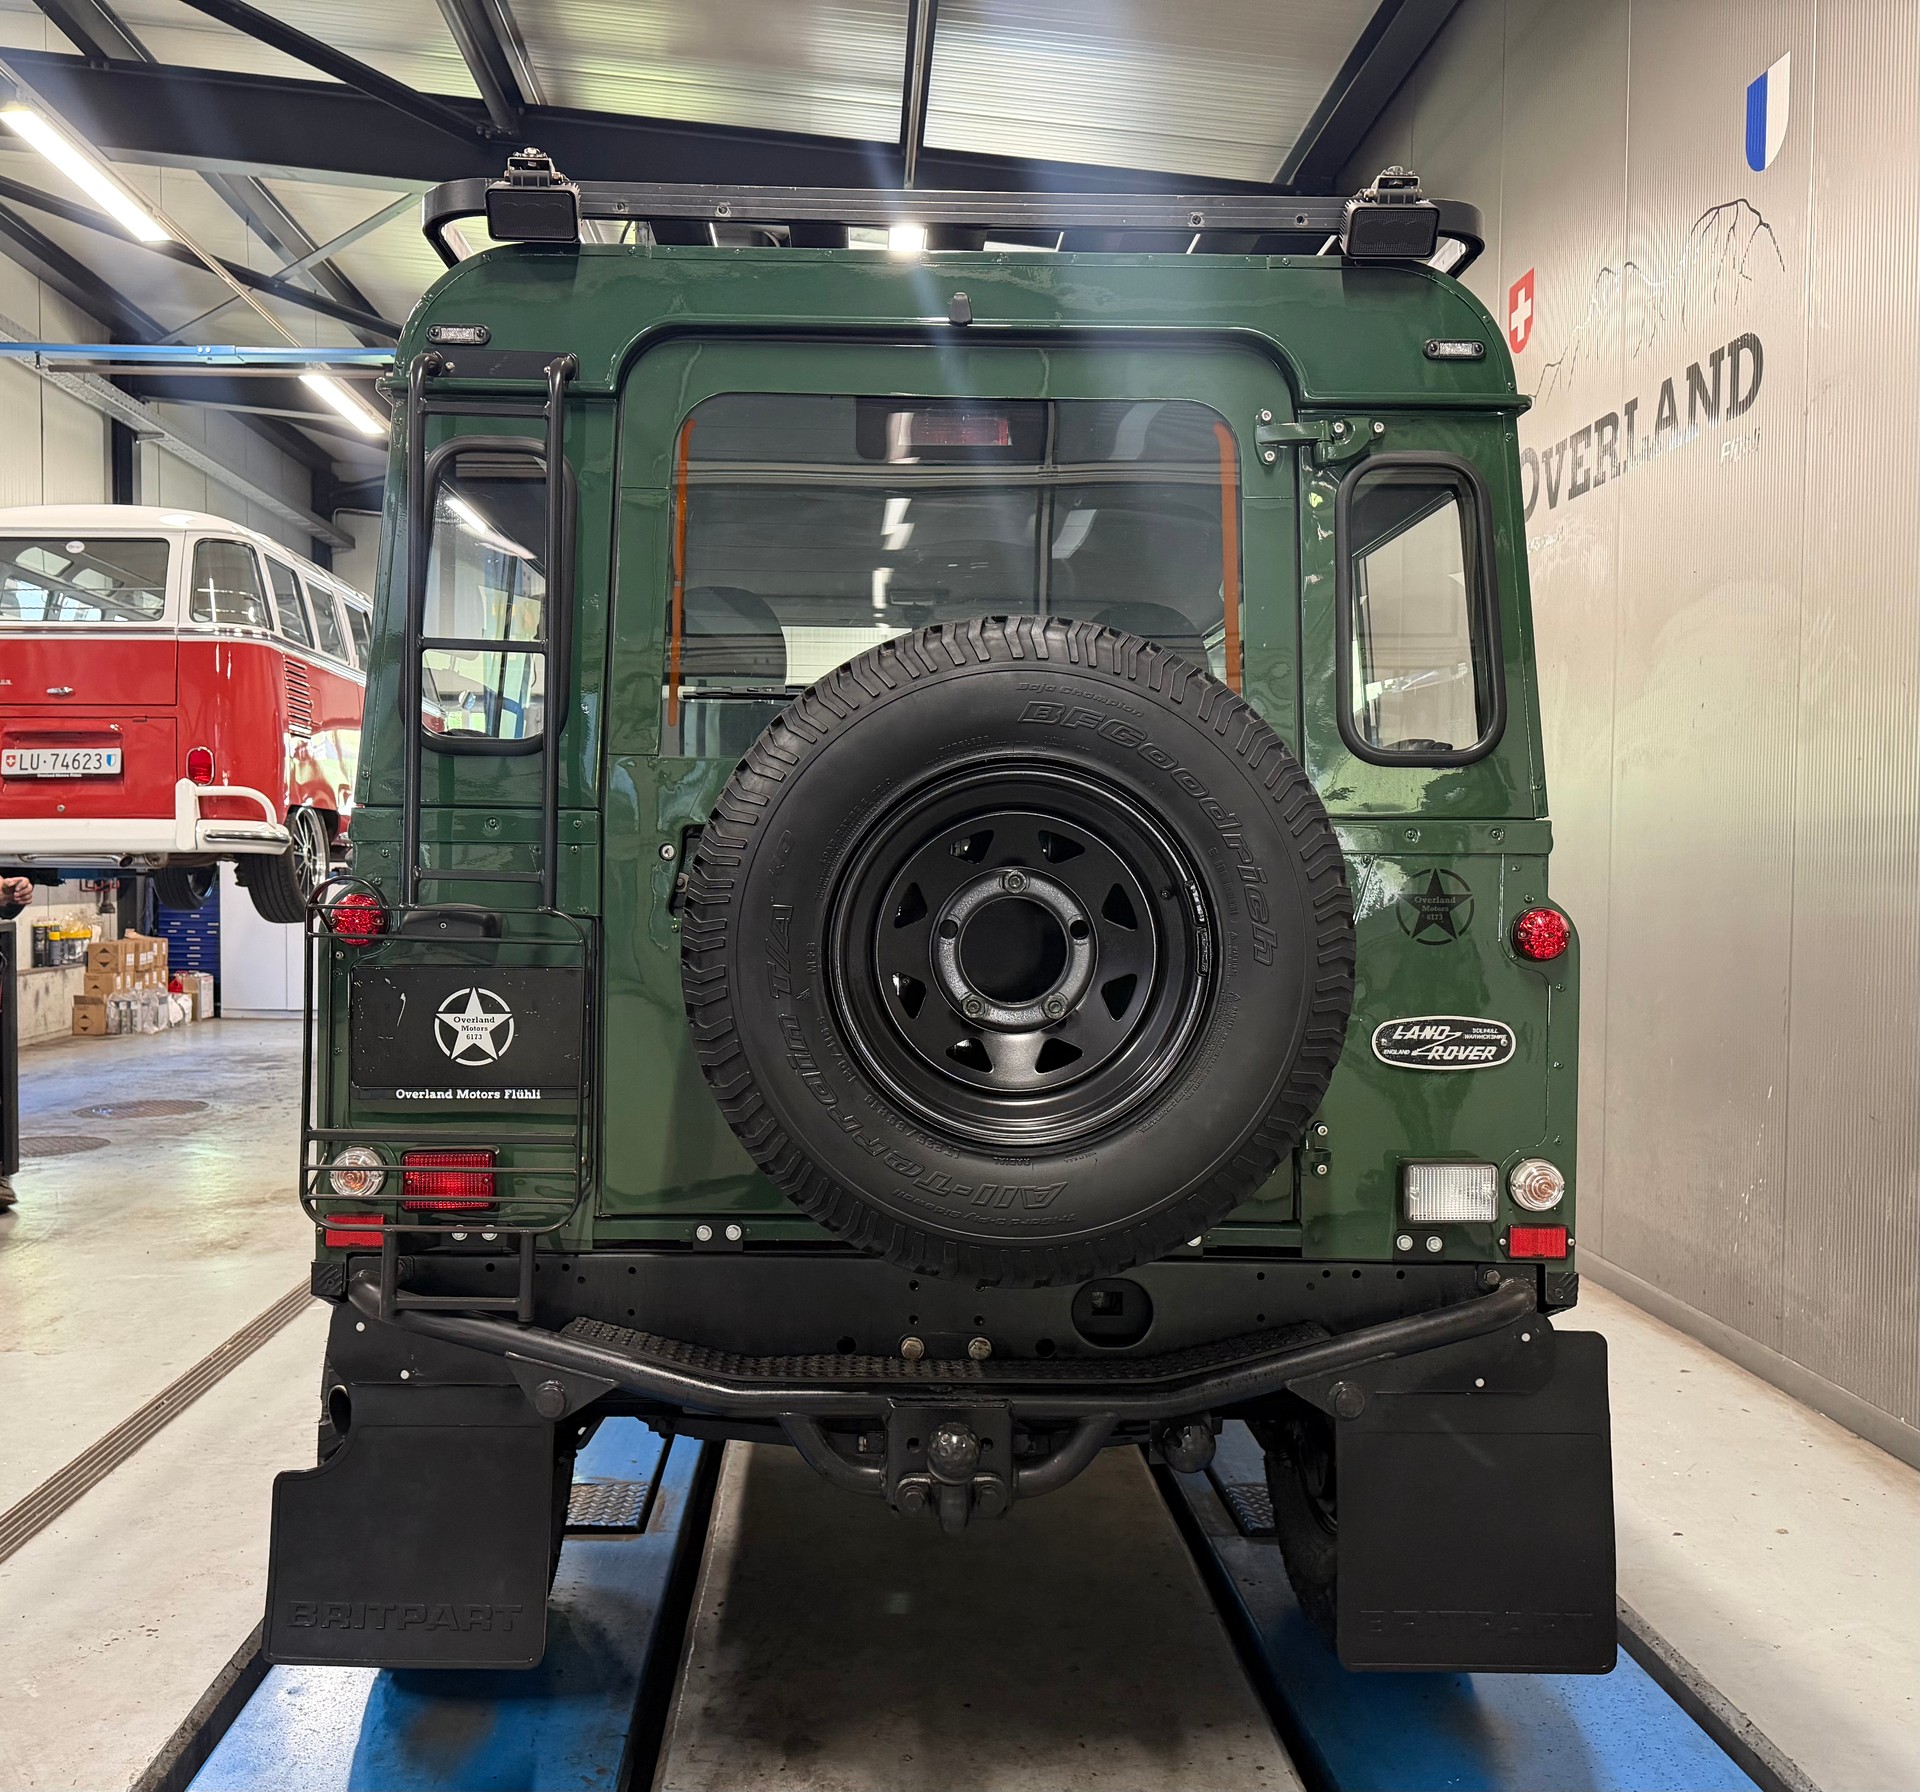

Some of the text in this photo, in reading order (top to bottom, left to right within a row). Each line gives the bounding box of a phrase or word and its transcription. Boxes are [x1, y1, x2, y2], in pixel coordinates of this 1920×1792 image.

[1521, 332, 1764, 523] OVERLAND
[1017, 700, 1277, 967] BFGoodrich
[768, 902, 795, 1000] T/A
[453, 1015, 495, 1024] Overland
[1392, 1025, 1451, 1040] LAND
[1427, 1045, 1498, 1060] ROVER
[395, 1089, 541, 1100] Overland Motors Flühli
[778, 1012, 1070, 1208] All-Terrain
[287, 1601, 522, 1632] BRITPART
